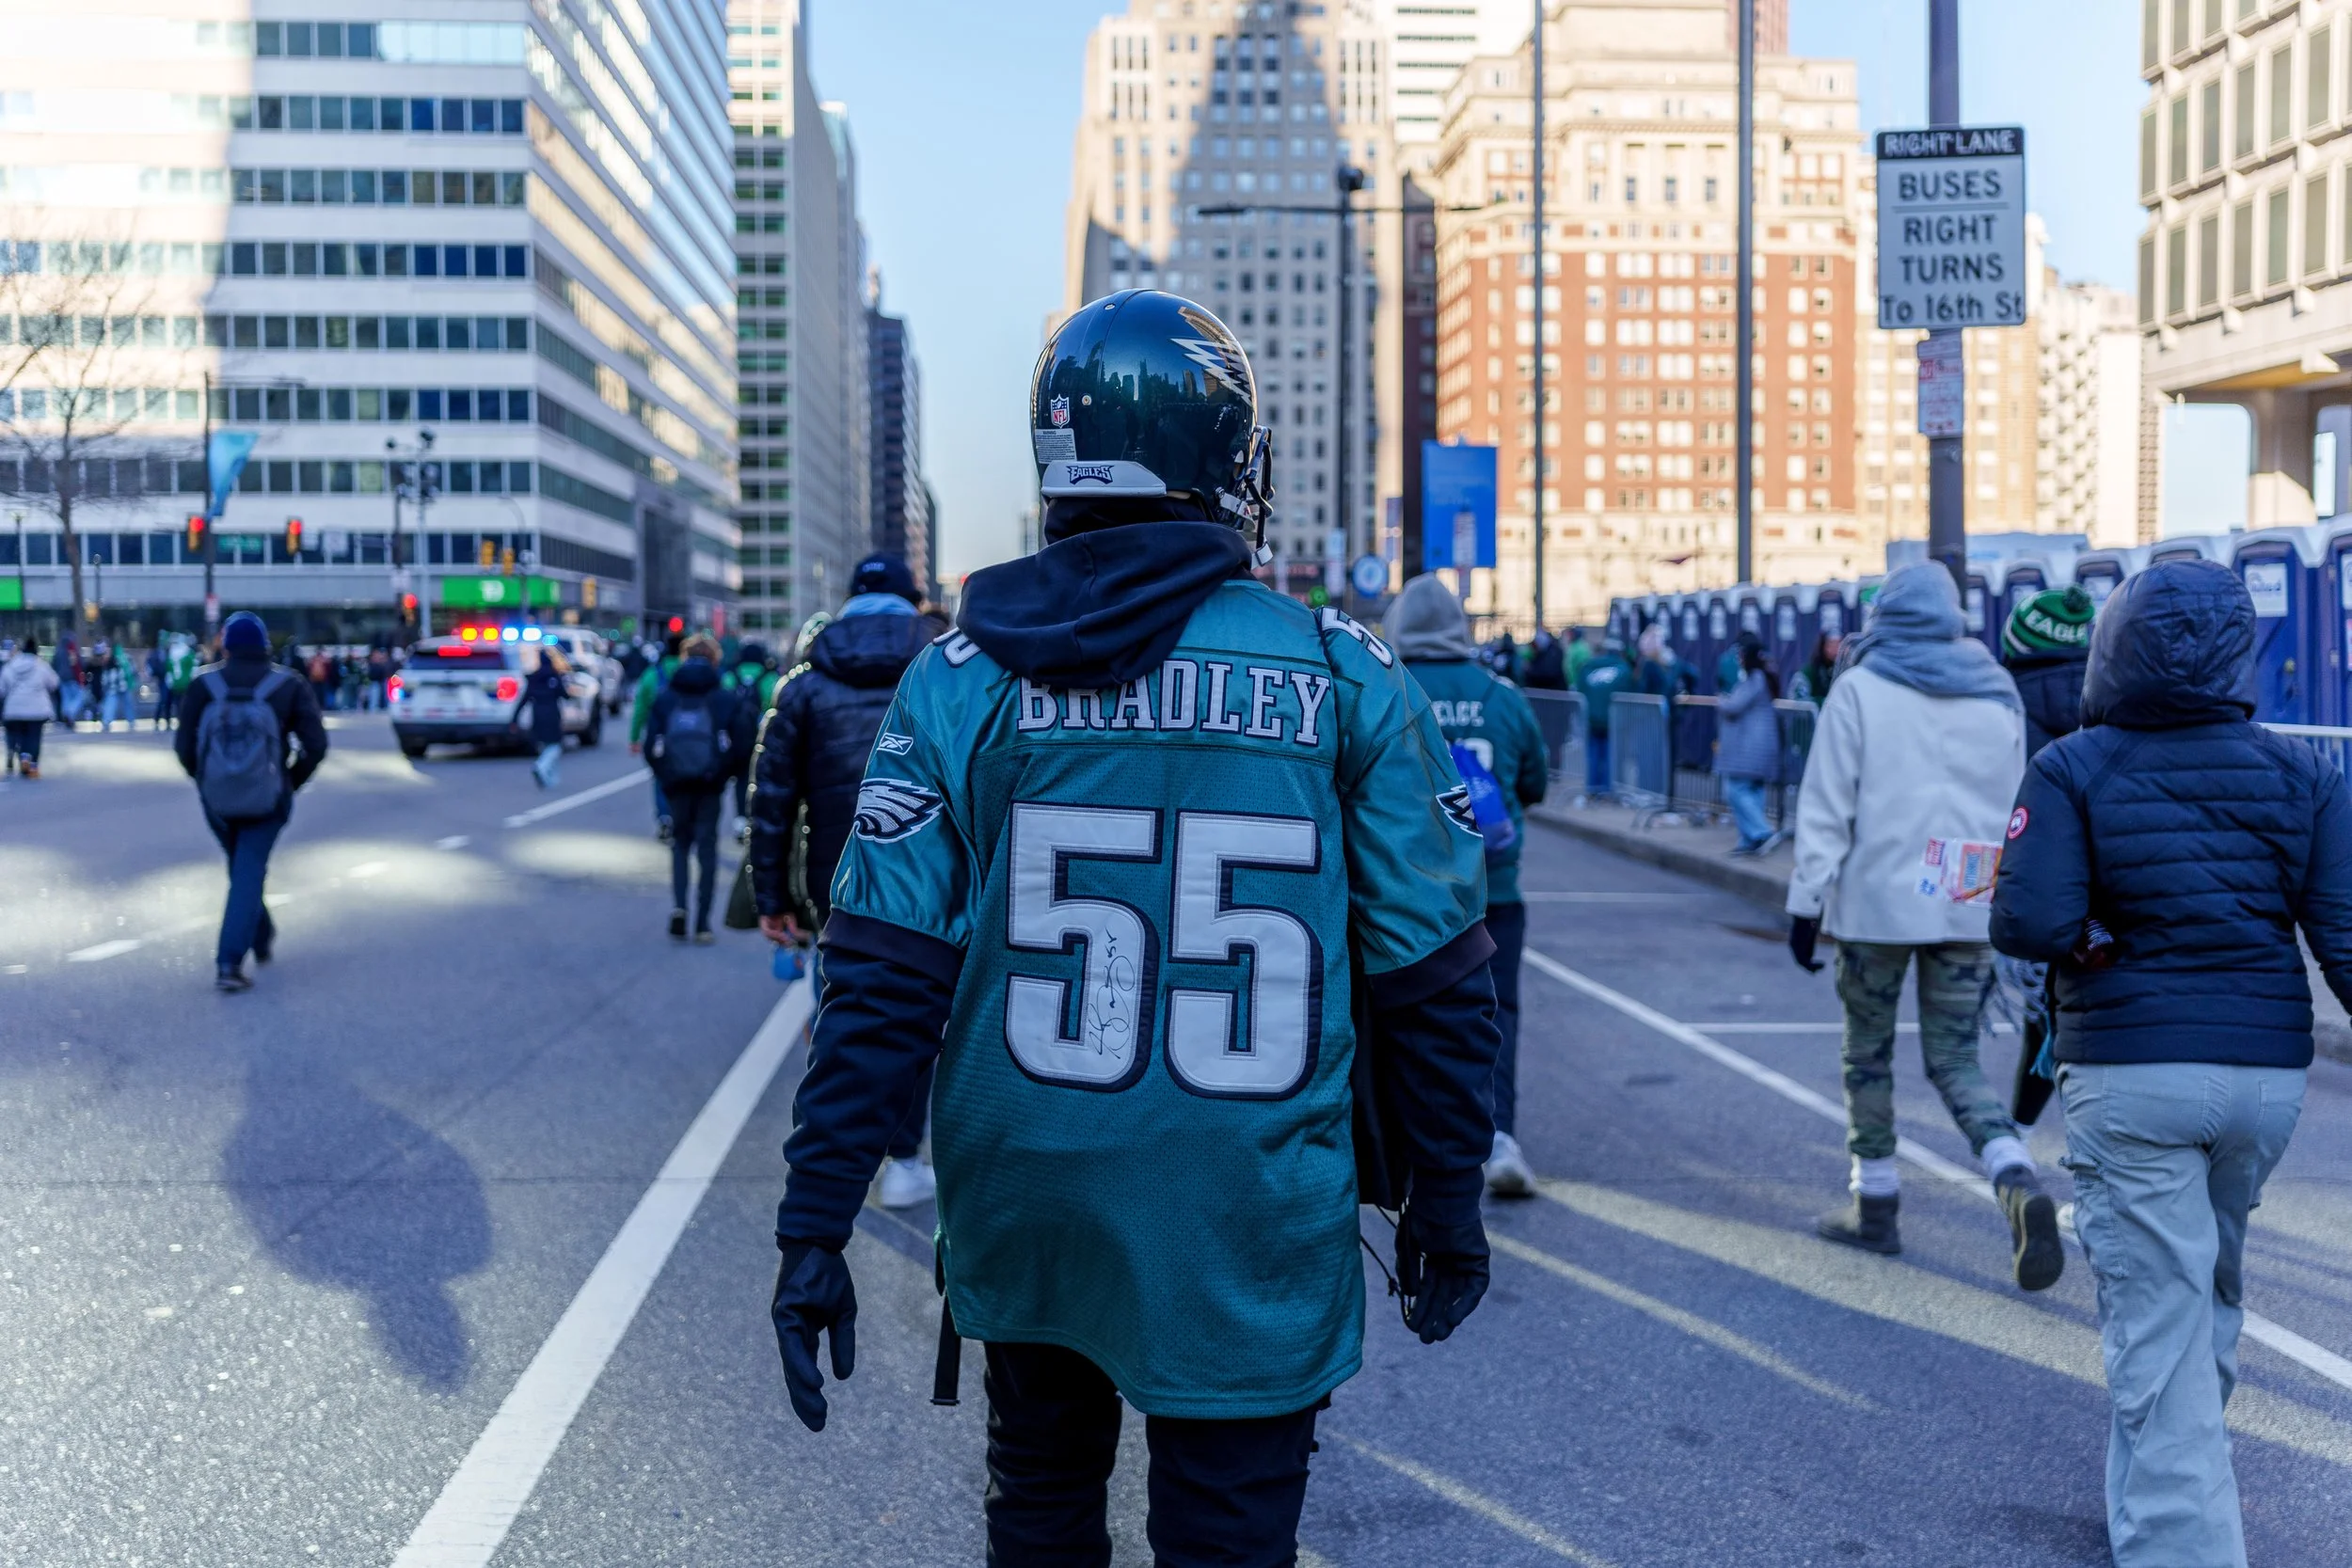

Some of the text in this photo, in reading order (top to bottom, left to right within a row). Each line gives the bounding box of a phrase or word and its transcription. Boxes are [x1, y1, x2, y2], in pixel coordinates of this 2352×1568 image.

[1884, 129, 2015, 157] RIGHT LANE
[1899, 170, 2002, 200] BUSES
[1904, 214, 1996, 245] RIGHT
[1899, 252, 2004, 284] TURNS
[1883, 291, 2022, 323] To 16th St
[1053, 409, 1067, 422] NFL
[1068, 465, 1114, 483] EAGLES
[1018, 659, 1330, 746] BRADLEY
[1004, 800, 1324, 1100] 55
